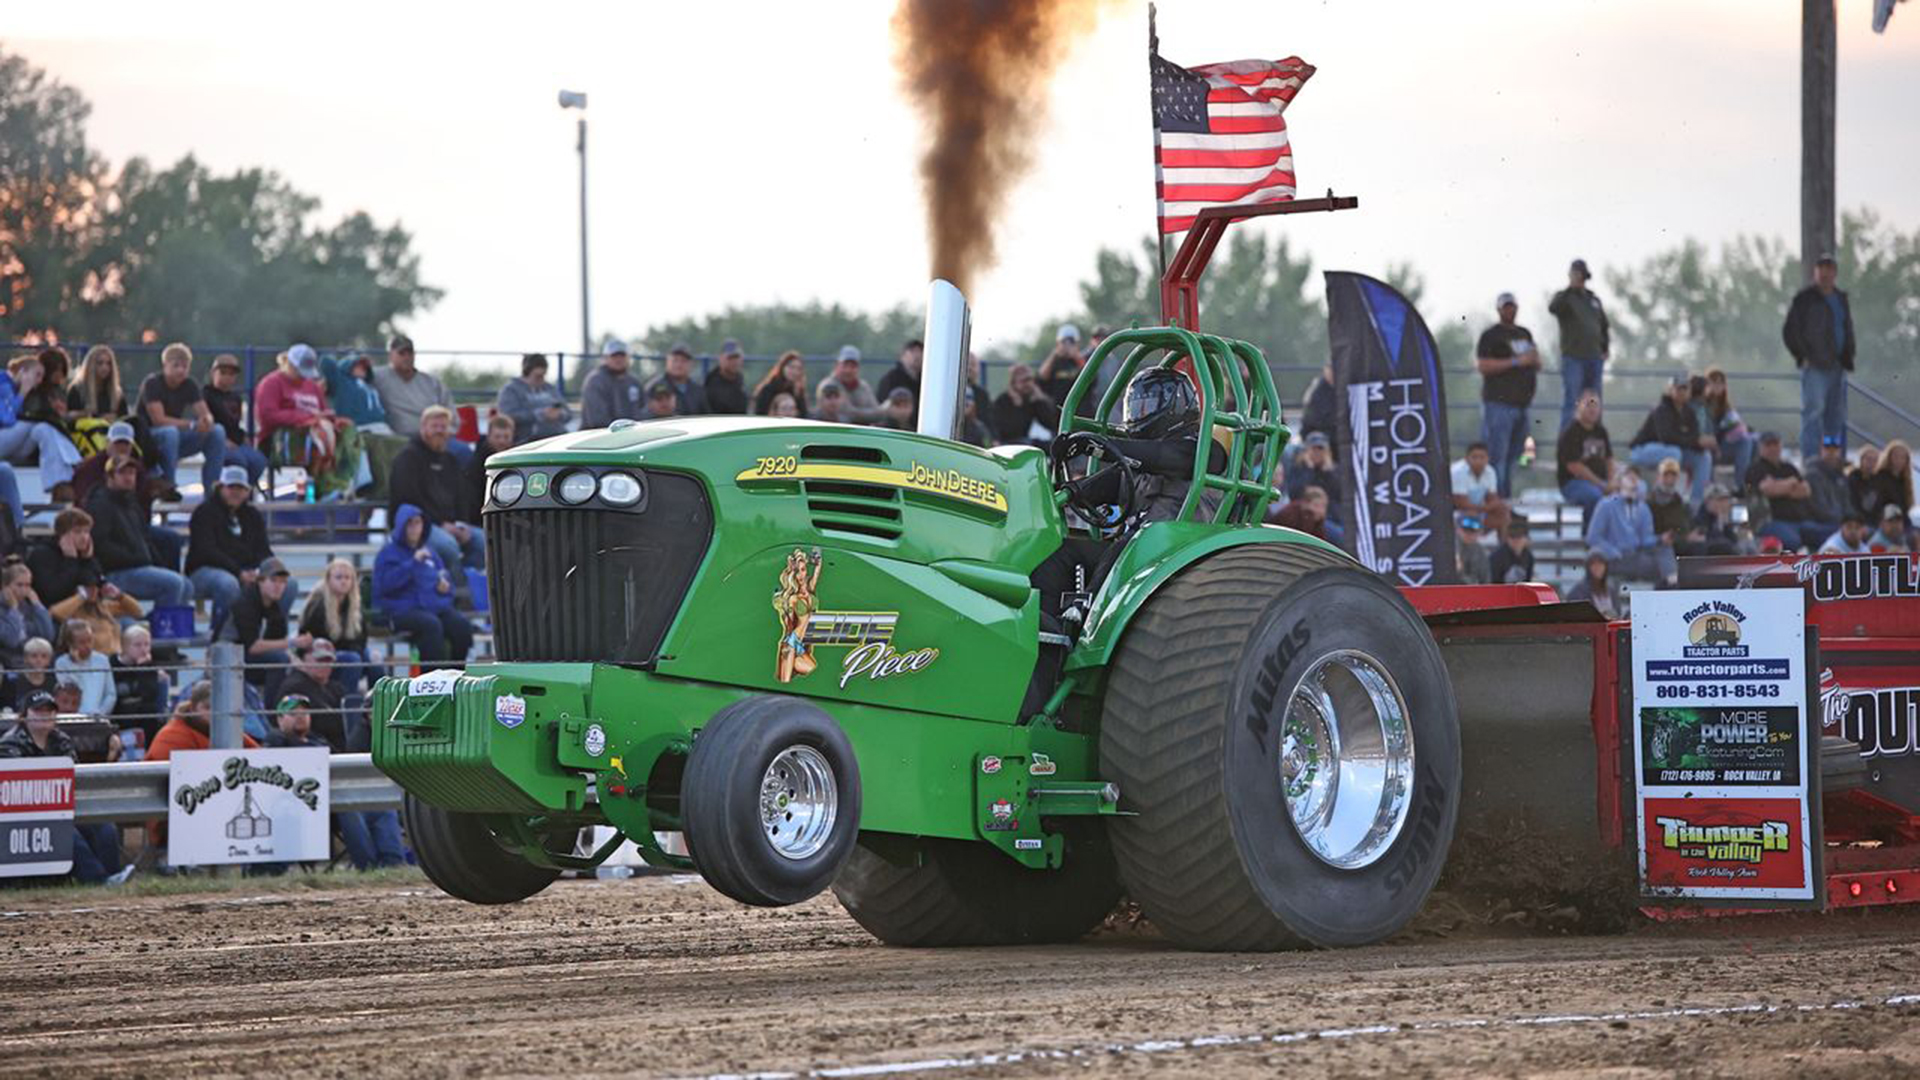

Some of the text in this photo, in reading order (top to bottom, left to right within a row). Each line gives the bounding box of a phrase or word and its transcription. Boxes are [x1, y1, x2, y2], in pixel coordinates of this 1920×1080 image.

[756, 455, 797, 475] 7920
[1367, 381, 1393, 575] MIDWES
[1794, 555, 1920, 602] The OUTL
[1682, 600, 1747, 624] Rock Valley
[1687, 646, 1747, 657] TRACTOR PARTS
[839, 641, 940, 690] Piece
[1649, 662, 1788, 677] www.rvtractorparts.com
[415, 681, 447, 694] LPS-7
[1245, 617, 1312, 755] Mitas
[1819, 684, 1851, 728] The
[1720, 711, 1768, 724] MORE
[1700, 724, 1768, 743] POWER
[223, 756, 294, 790] Elevator
[1723, 770, 1745, 781] ROCK
[0, 777, 72, 806] OMMUNITY
[9, 827, 54, 854] OIL CO.
[1691, 847, 1706, 856] the
[1707, 843, 1762, 863] valley
[1709, 867, 1735, 879] Valley
